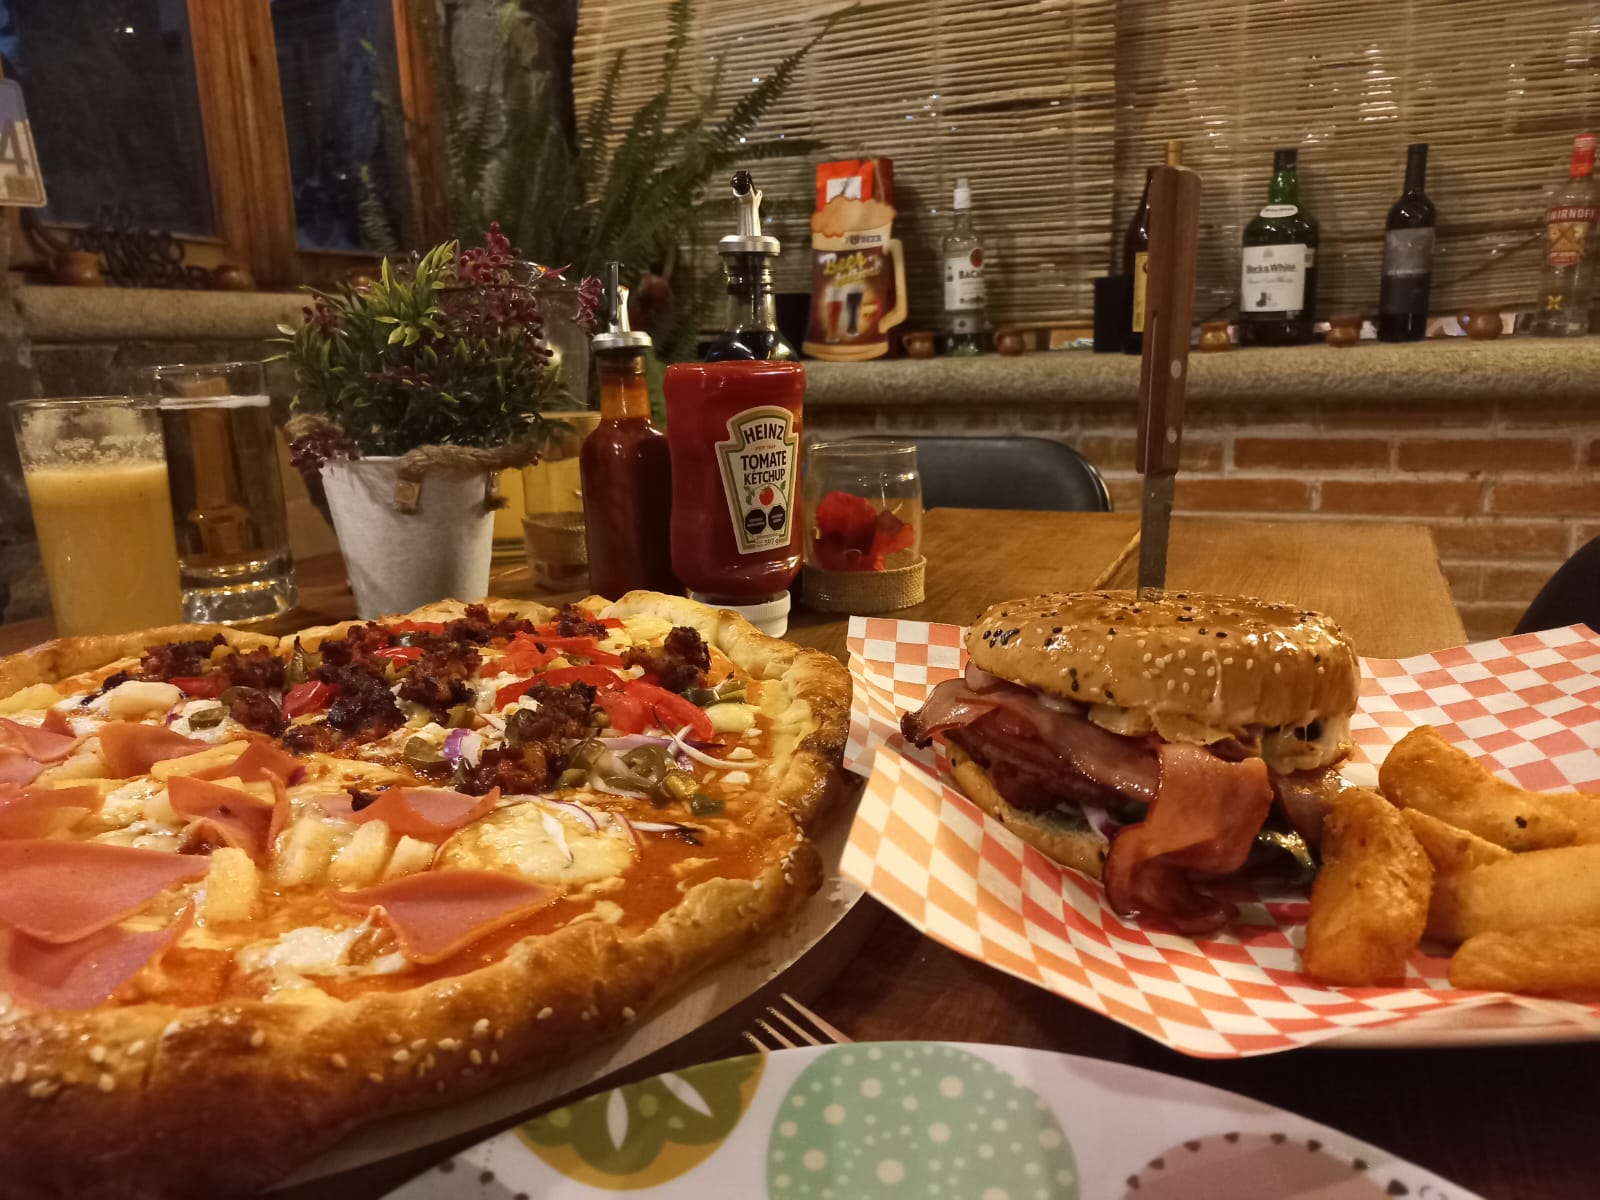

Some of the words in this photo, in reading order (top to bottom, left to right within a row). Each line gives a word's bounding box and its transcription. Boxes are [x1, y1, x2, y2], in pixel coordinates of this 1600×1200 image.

[743, 424, 784, 444] HEINZ
[740, 450, 787, 471] TOMATE
[743, 468, 786, 485] KETCHUP
